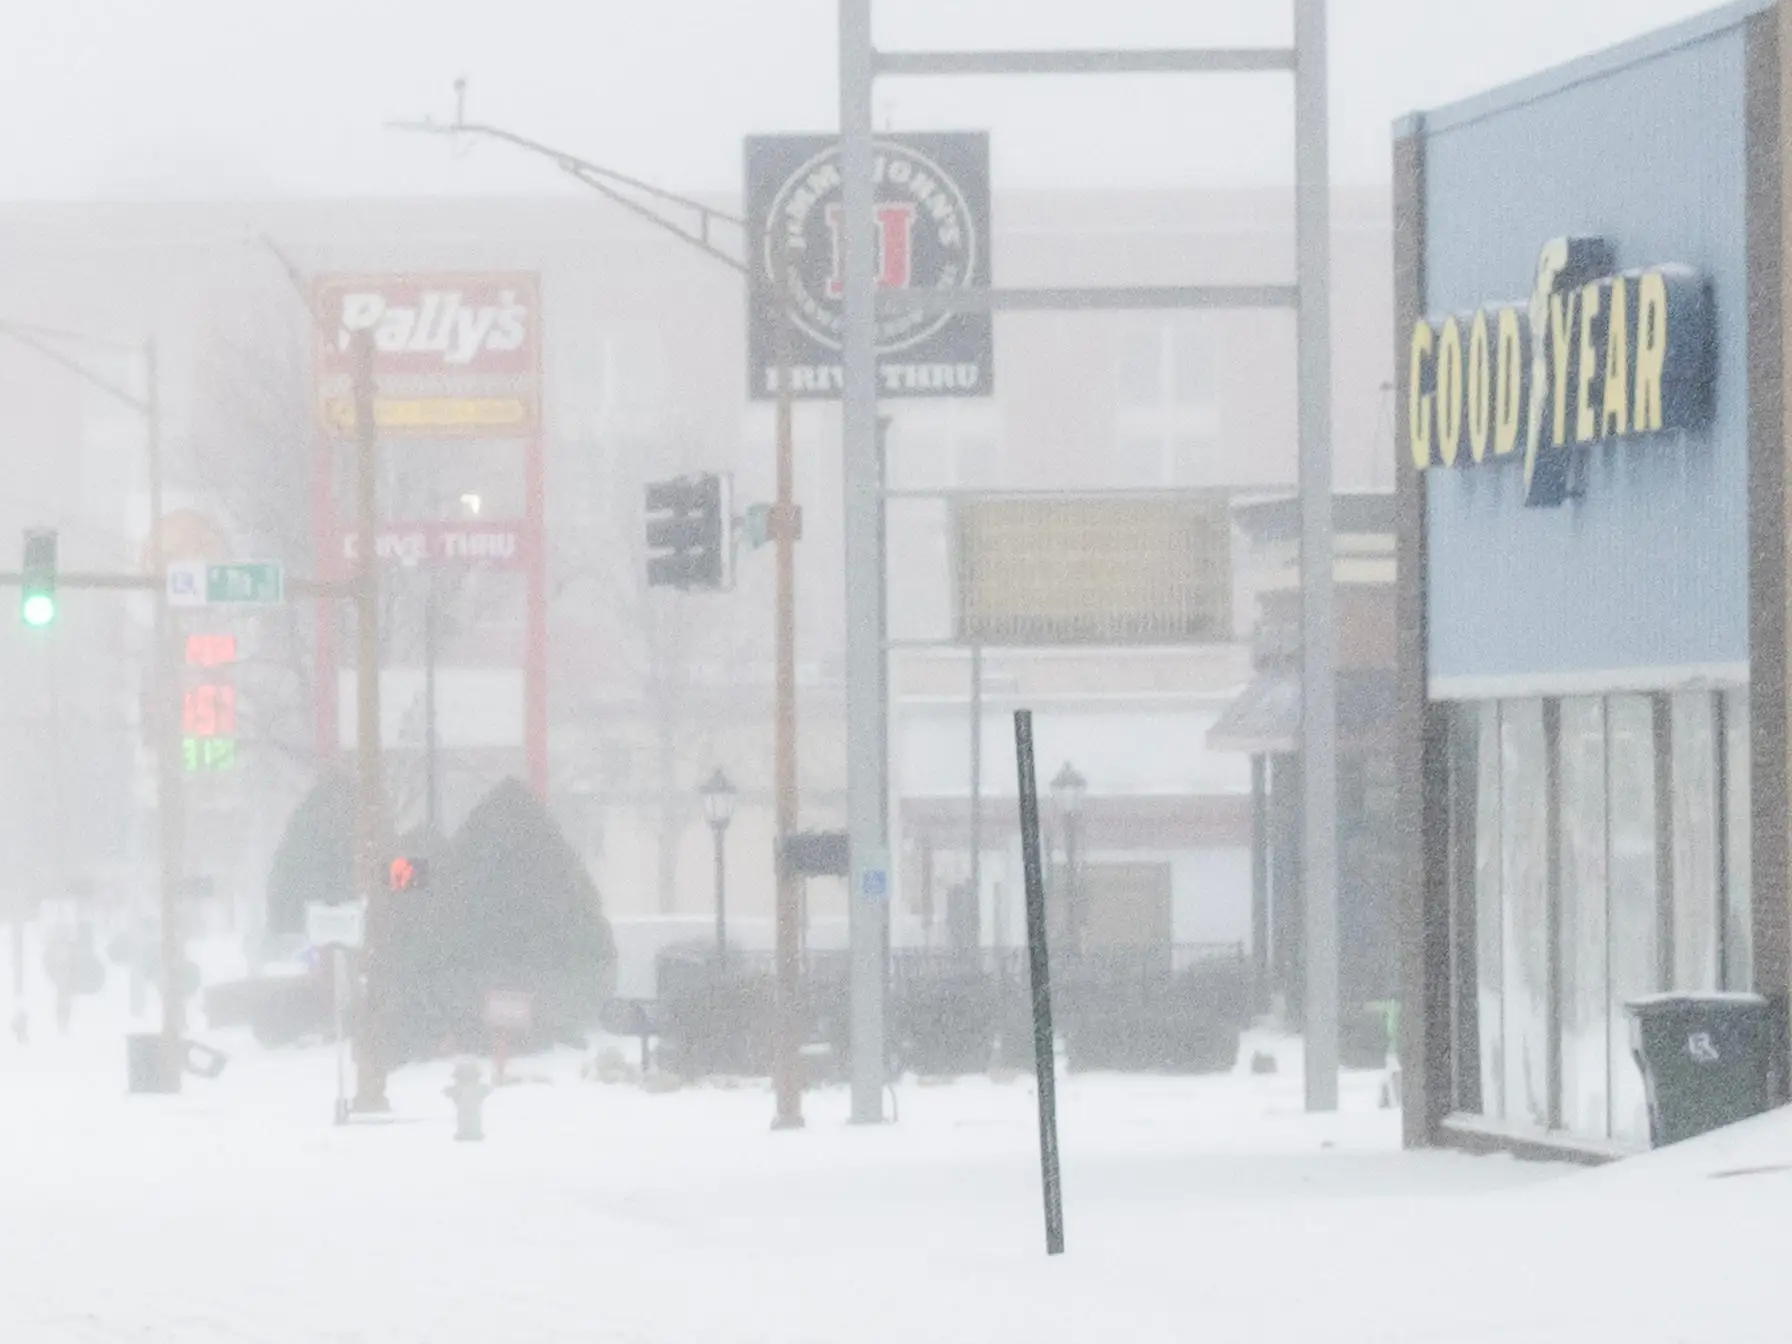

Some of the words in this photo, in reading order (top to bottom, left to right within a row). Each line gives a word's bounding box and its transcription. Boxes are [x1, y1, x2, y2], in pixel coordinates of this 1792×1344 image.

[765, 363, 844, 391] RIV
[879, 362, 979, 390] THRU
[1408, 272, 1668, 471] GOODYEAR
